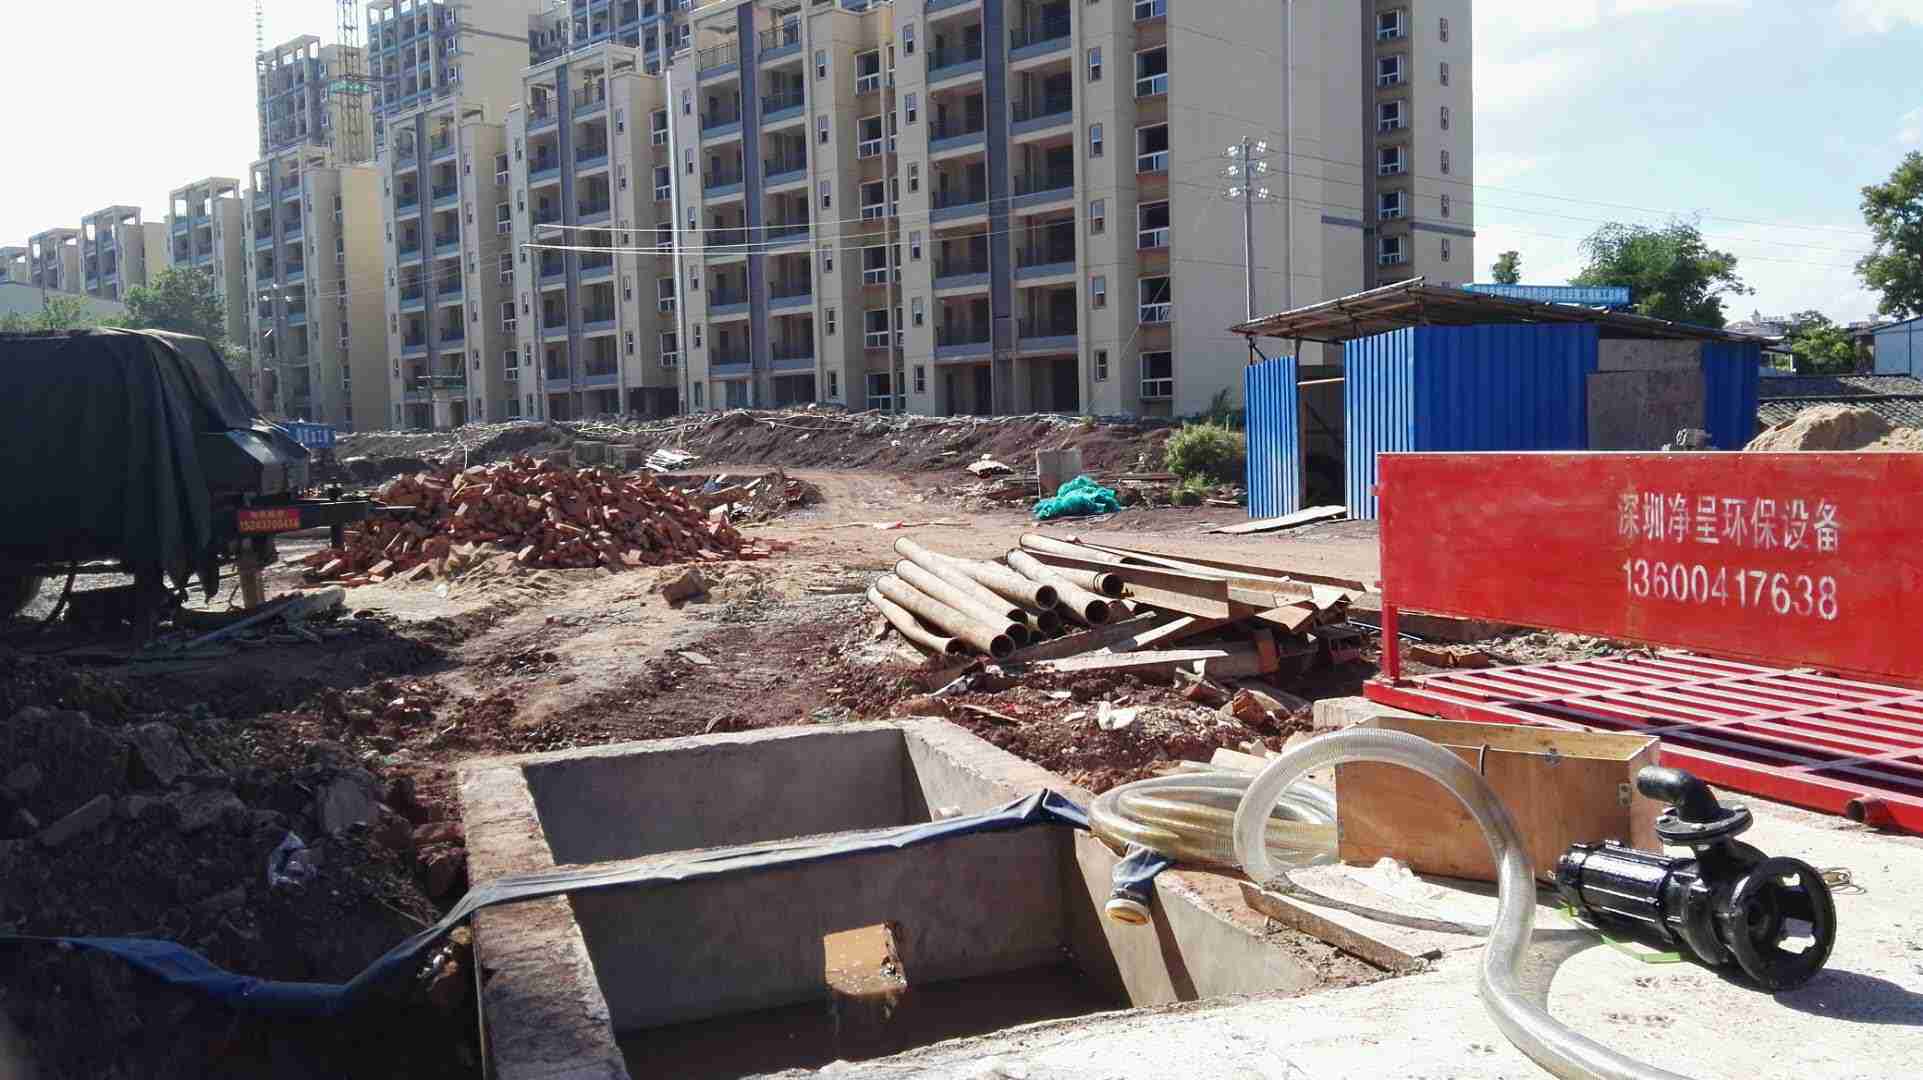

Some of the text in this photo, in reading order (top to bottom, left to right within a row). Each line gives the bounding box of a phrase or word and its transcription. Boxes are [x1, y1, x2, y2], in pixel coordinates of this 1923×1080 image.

[1618, 490, 1840, 552] 深圳净呈环保设备
[1623, 558, 1838, 620] 13600417638
